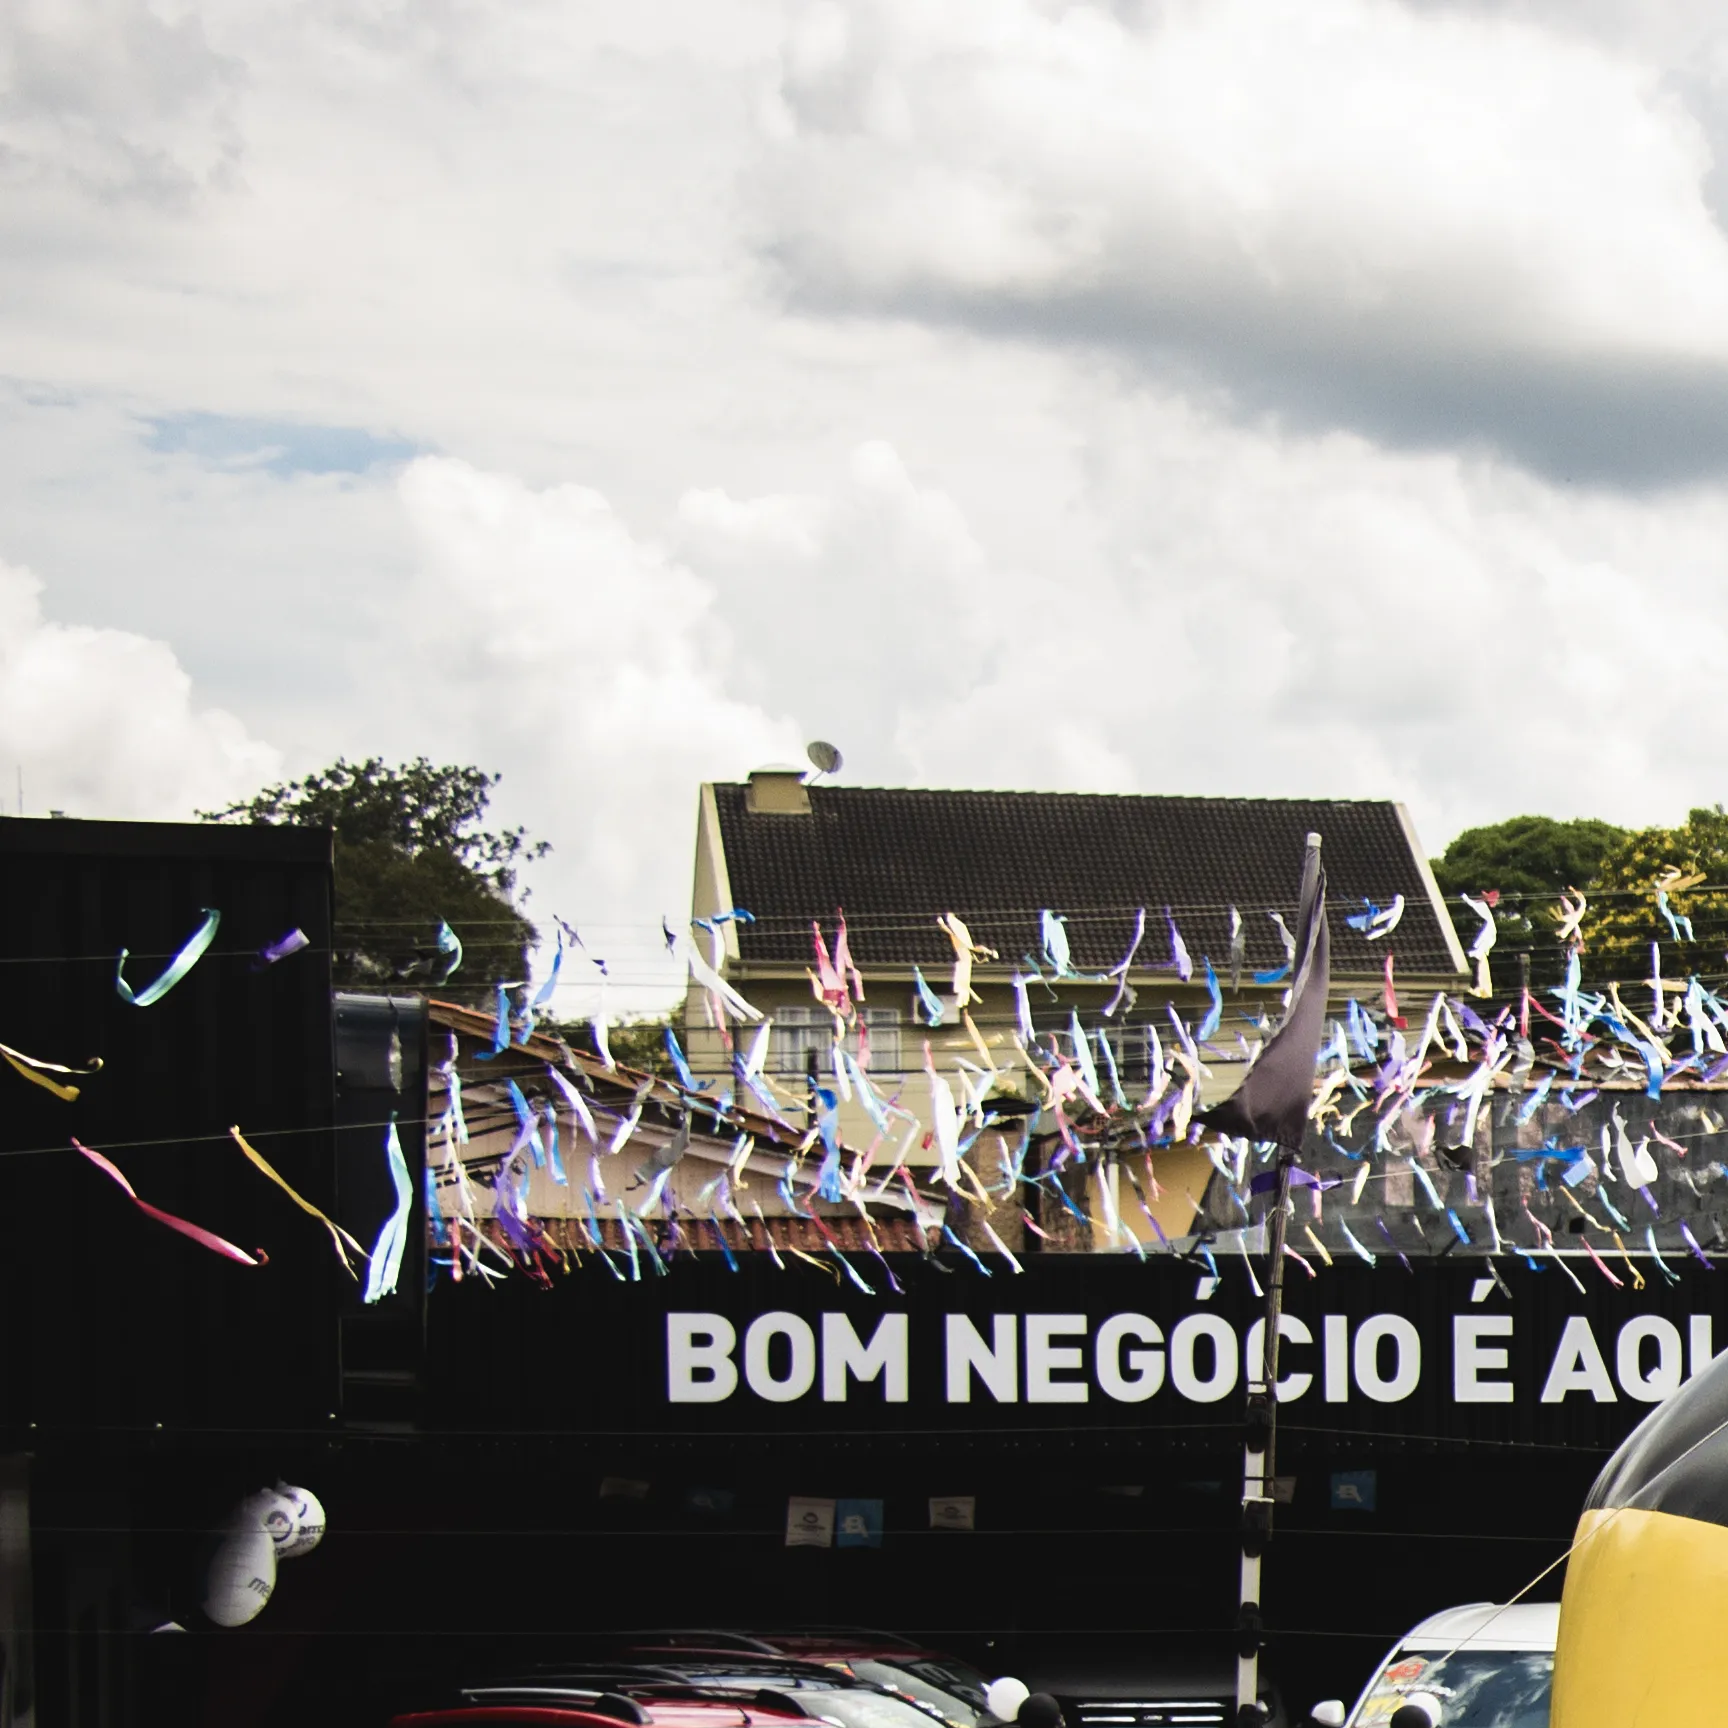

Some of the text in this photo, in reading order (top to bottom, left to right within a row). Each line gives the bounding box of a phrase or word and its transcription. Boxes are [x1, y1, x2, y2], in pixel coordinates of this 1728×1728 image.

[668, 1312, 908, 1402] BOM
[947, 1277, 1420, 1402] NEGÓCIO
[1454, 1279, 1513, 1402] É
